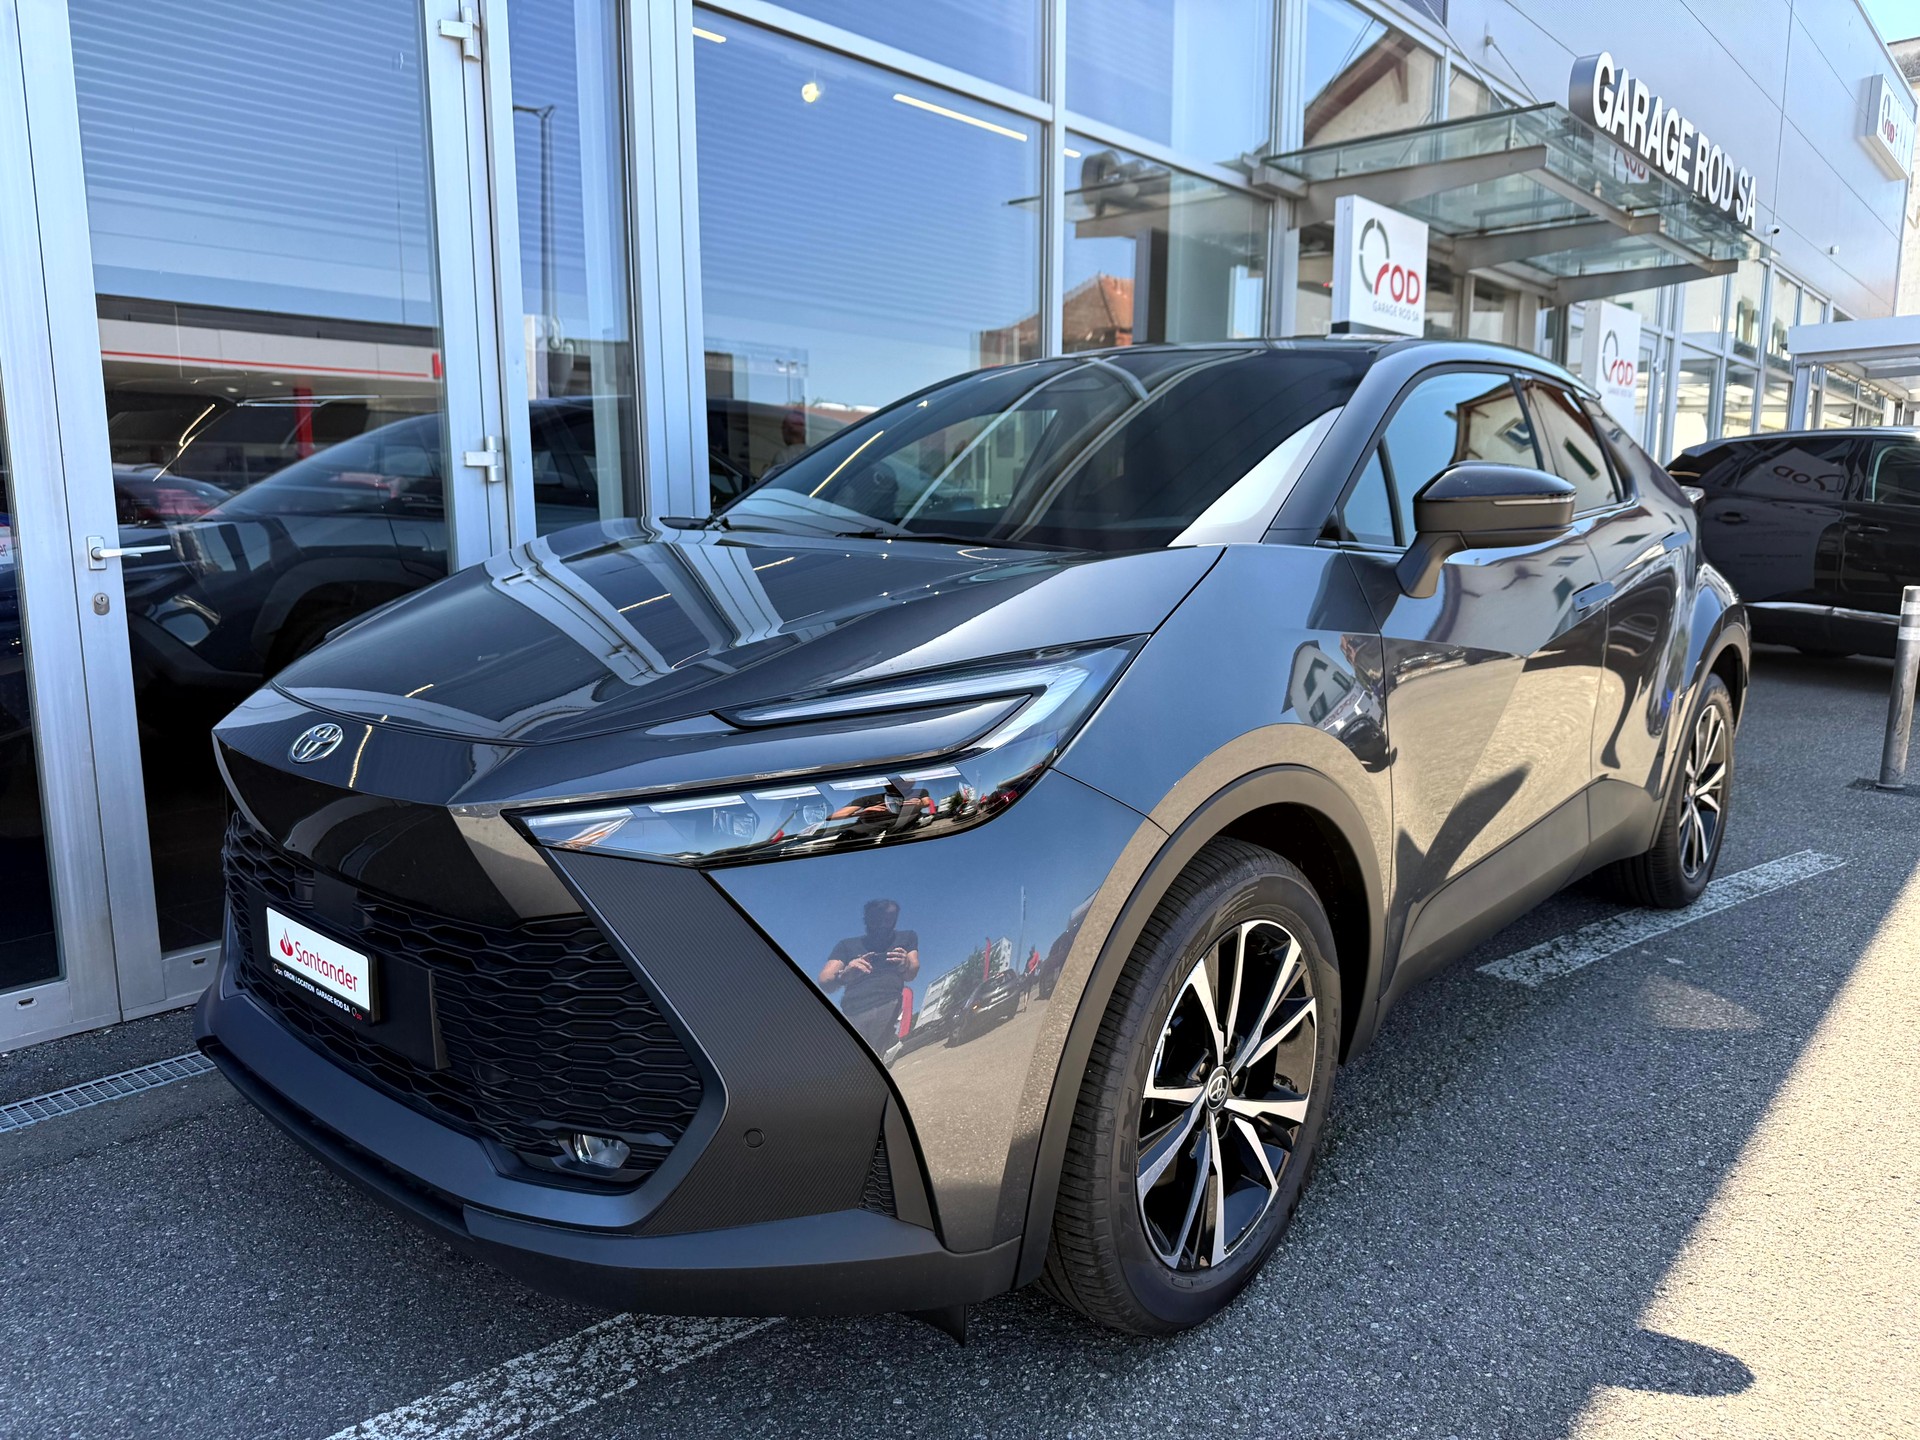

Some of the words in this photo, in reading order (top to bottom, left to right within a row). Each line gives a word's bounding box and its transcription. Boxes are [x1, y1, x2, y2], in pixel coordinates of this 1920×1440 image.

[1593, 51, 1694, 185] GARAGE
[1694, 131, 1734, 212] ROD
[1736, 166, 1756, 231] SA
[295, 941, 358, 992] Santander
